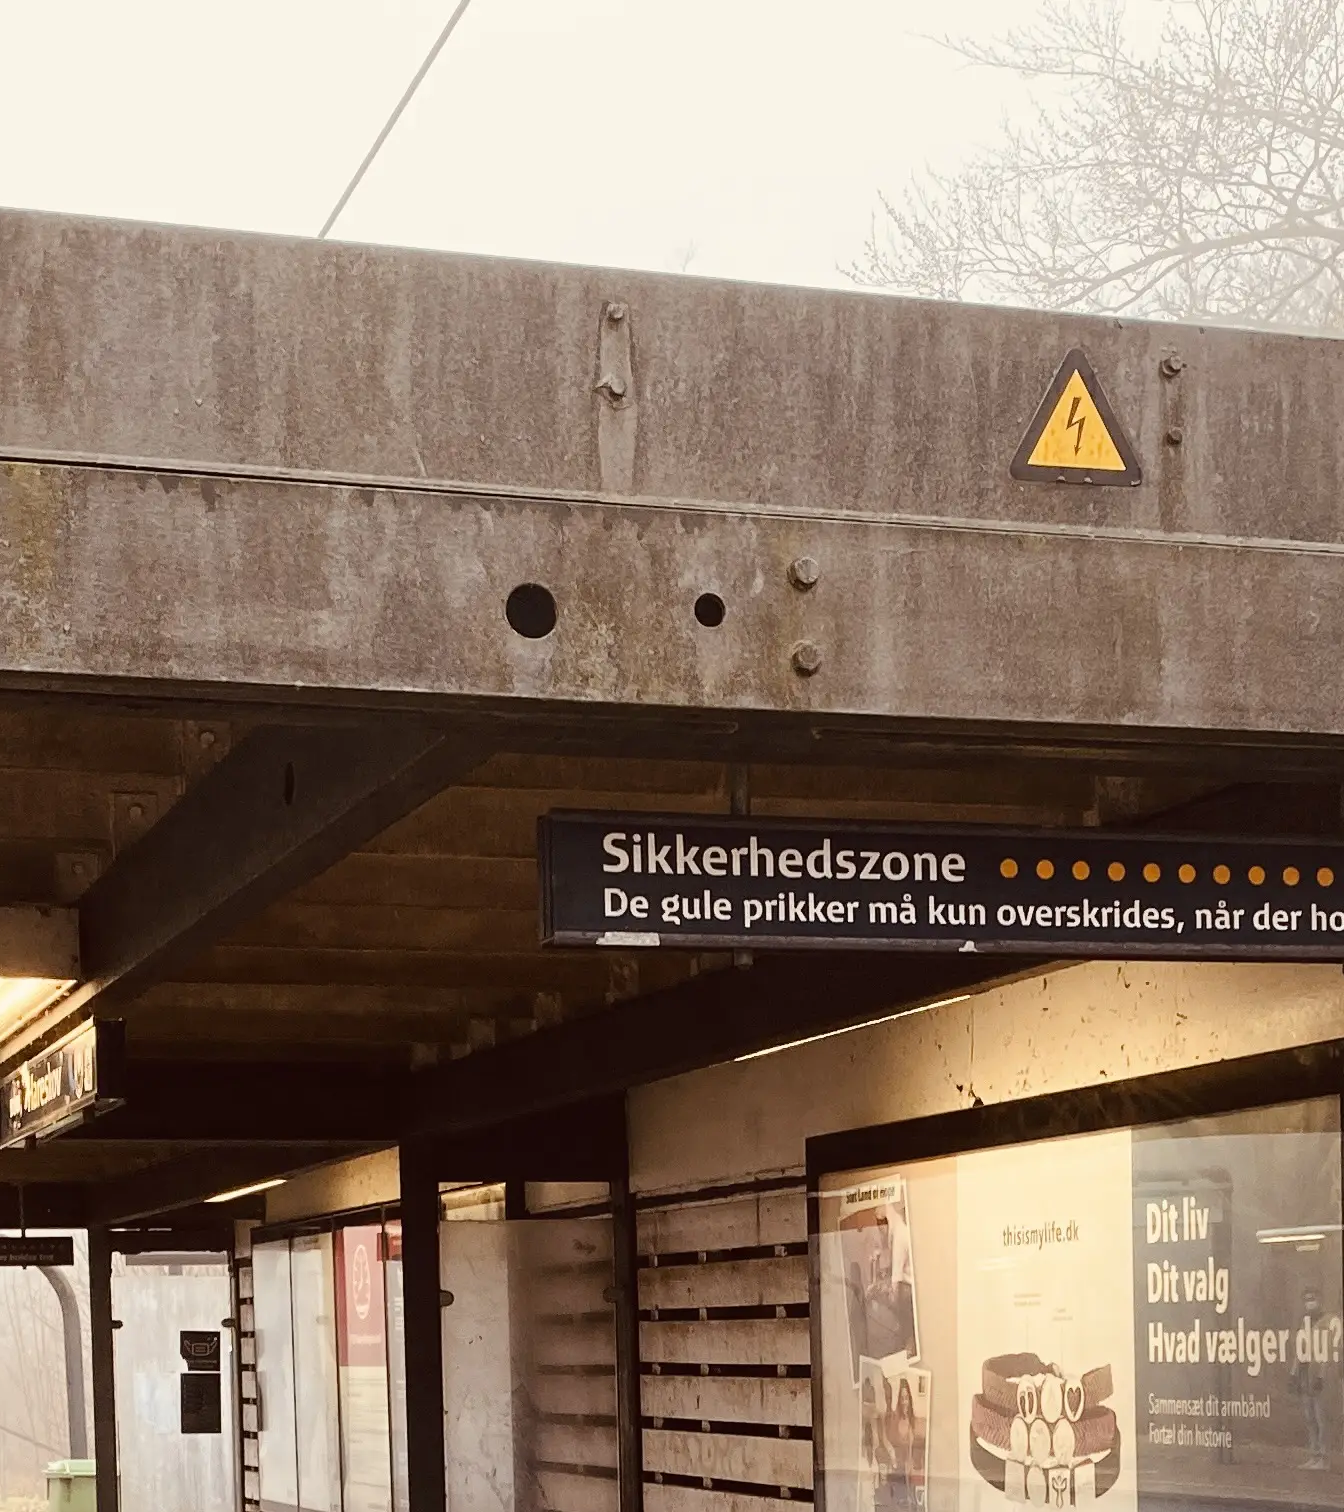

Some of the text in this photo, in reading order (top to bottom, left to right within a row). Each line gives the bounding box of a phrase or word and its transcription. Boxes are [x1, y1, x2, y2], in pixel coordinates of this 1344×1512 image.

[602, 832, 966, 882] Sikkerhedszone
[605, 887, 649, 918] De
[661, 890, 732, 926] gule
[744, 892, 859, 928] prikker
[868, 893, 917, 925] må
[928, 895, 986, 926] kun
[996, 898, 1184, 934] overskrides,
[1194, 900, 1245, 930] når
[1252, 902, 1304, 932] der
[1002, 1219, 1079, 1250] thisismylife.dk
[1146, 1196, 1209, 1244] Dit liv
[1147, 1256, 1229, 1313] Dit valg
[1148, 1316, 1342, 1376] Hvad vælger du?
[1149, 1392, 1271, 1418] Sammensæt dit armbånd
[1149, 1422, 1232, 1449] Fortæl din historie
